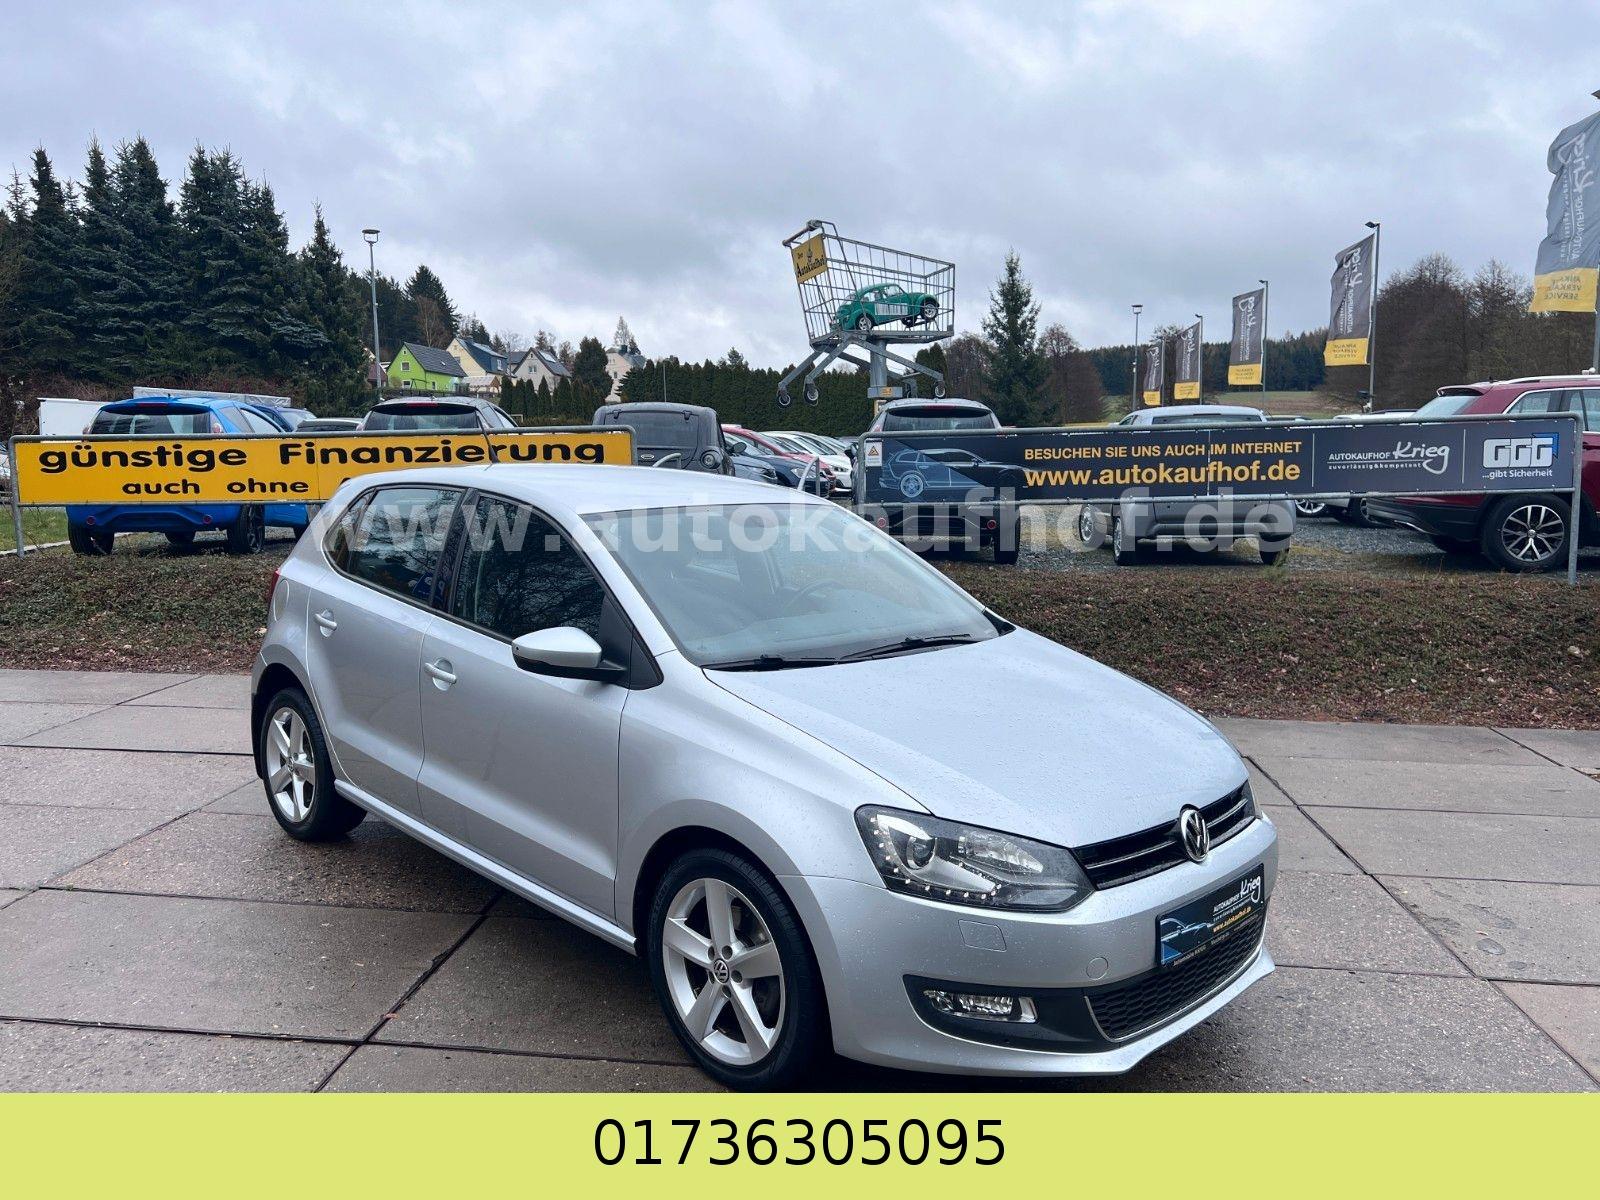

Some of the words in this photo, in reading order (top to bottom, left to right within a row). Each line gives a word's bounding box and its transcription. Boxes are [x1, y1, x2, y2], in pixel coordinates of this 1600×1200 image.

[38, 443, 248, 474] günstige
[280, 438, 606, 466] Finanzierung
[1024, 447, 1101, 460] BESUCHEN
[1105, 446, 1128, 458] SIE
[1131, 445, 1161, 458] UNS
[1164, 444, 1206, 457] AUCH
[1210, 443, 1228, 456] IM
[1231, 441, 1302, 455] INTERNET
[1328, 451, 1391, 461] AUTOKAUFHOF
[1392, 441, 1451, 475] Krieg
[121, 478, 201, 496] auch
[226, 477, 310, 494] ohne
[1024, 459, 1301, 488] www.autokaufhof.de
[1509, 468, 1554, 478] Sicherheit
[1240, 875, 1262, 904] Krieg
